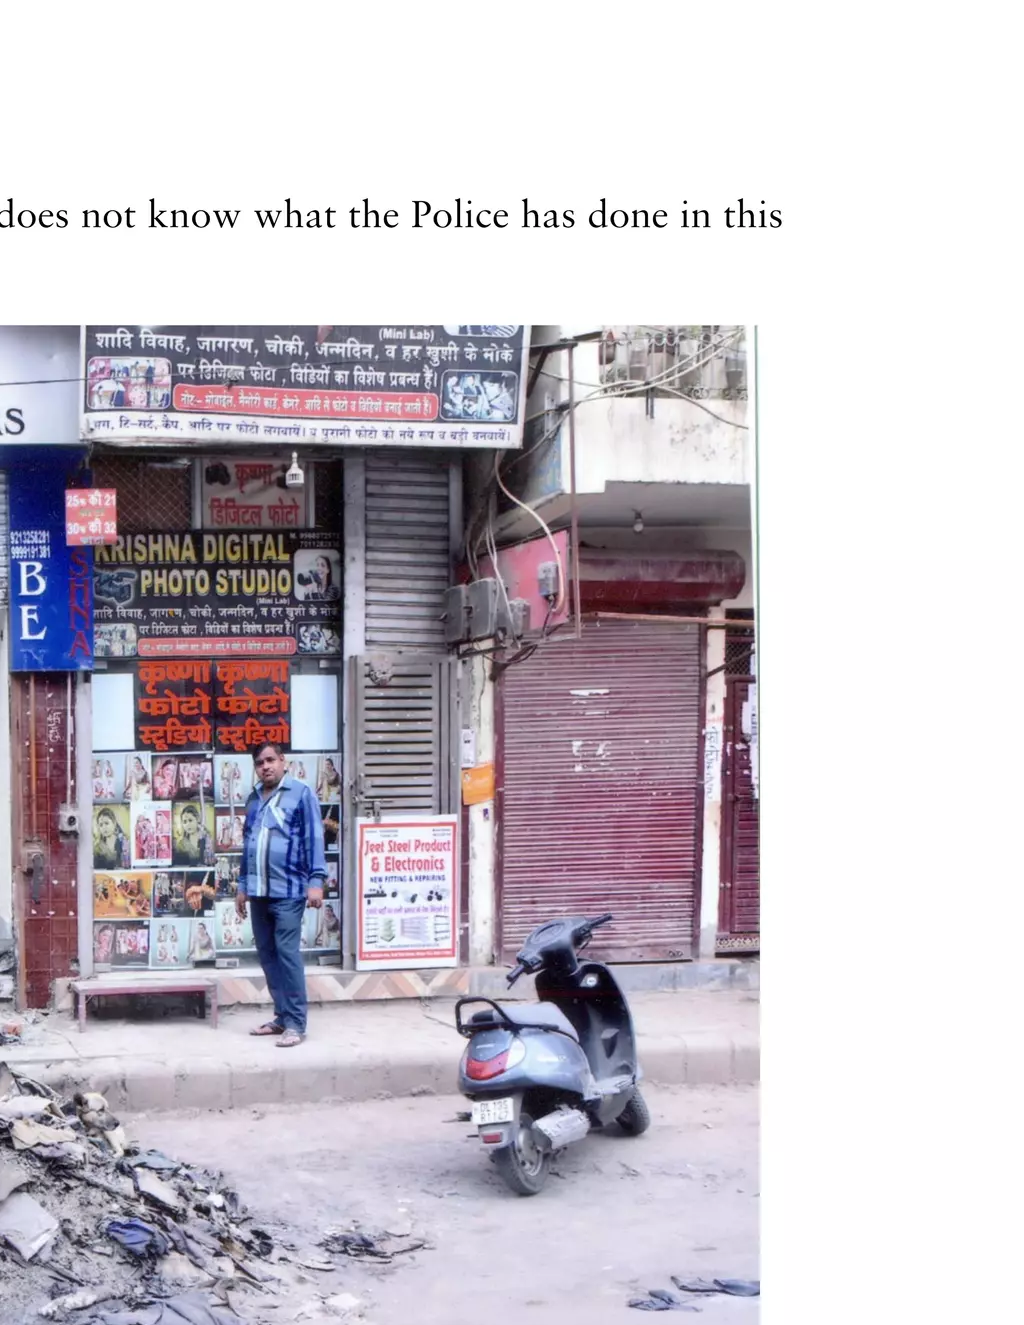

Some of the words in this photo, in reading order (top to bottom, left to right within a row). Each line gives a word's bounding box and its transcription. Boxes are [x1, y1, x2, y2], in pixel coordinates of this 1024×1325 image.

[95, 328, 134, 350] शादि
[384, 344, 397, 360] व
[402, 344, 423, 362] हर
[463, 343, 478, 363] के
[379, 327, 406, 342] (Mini
[409, 328, 435, 342] Lab)
[176, 363, 196, 380] पर
[334, 370, 350, 386] का
[202, 533, 291, 564] DIGITAL
[139, 568, 211, 597] PHOTO
[215, 567, 293, 597] STUDIO
[138, 660, 212, 695] कृष्णा
[216, 660, 290, 694] कृष्णा
[138, 688, 212, 716] फोटो
[217, 686, 289, 715] फोटो
[364, 840, 385, 856] Jeet
[387, 839, 411, 853] Steel
[414, 838, 451, 853] Product
[371, 856, 380, 873] &
[384, 855, 446, 873] Electronics
